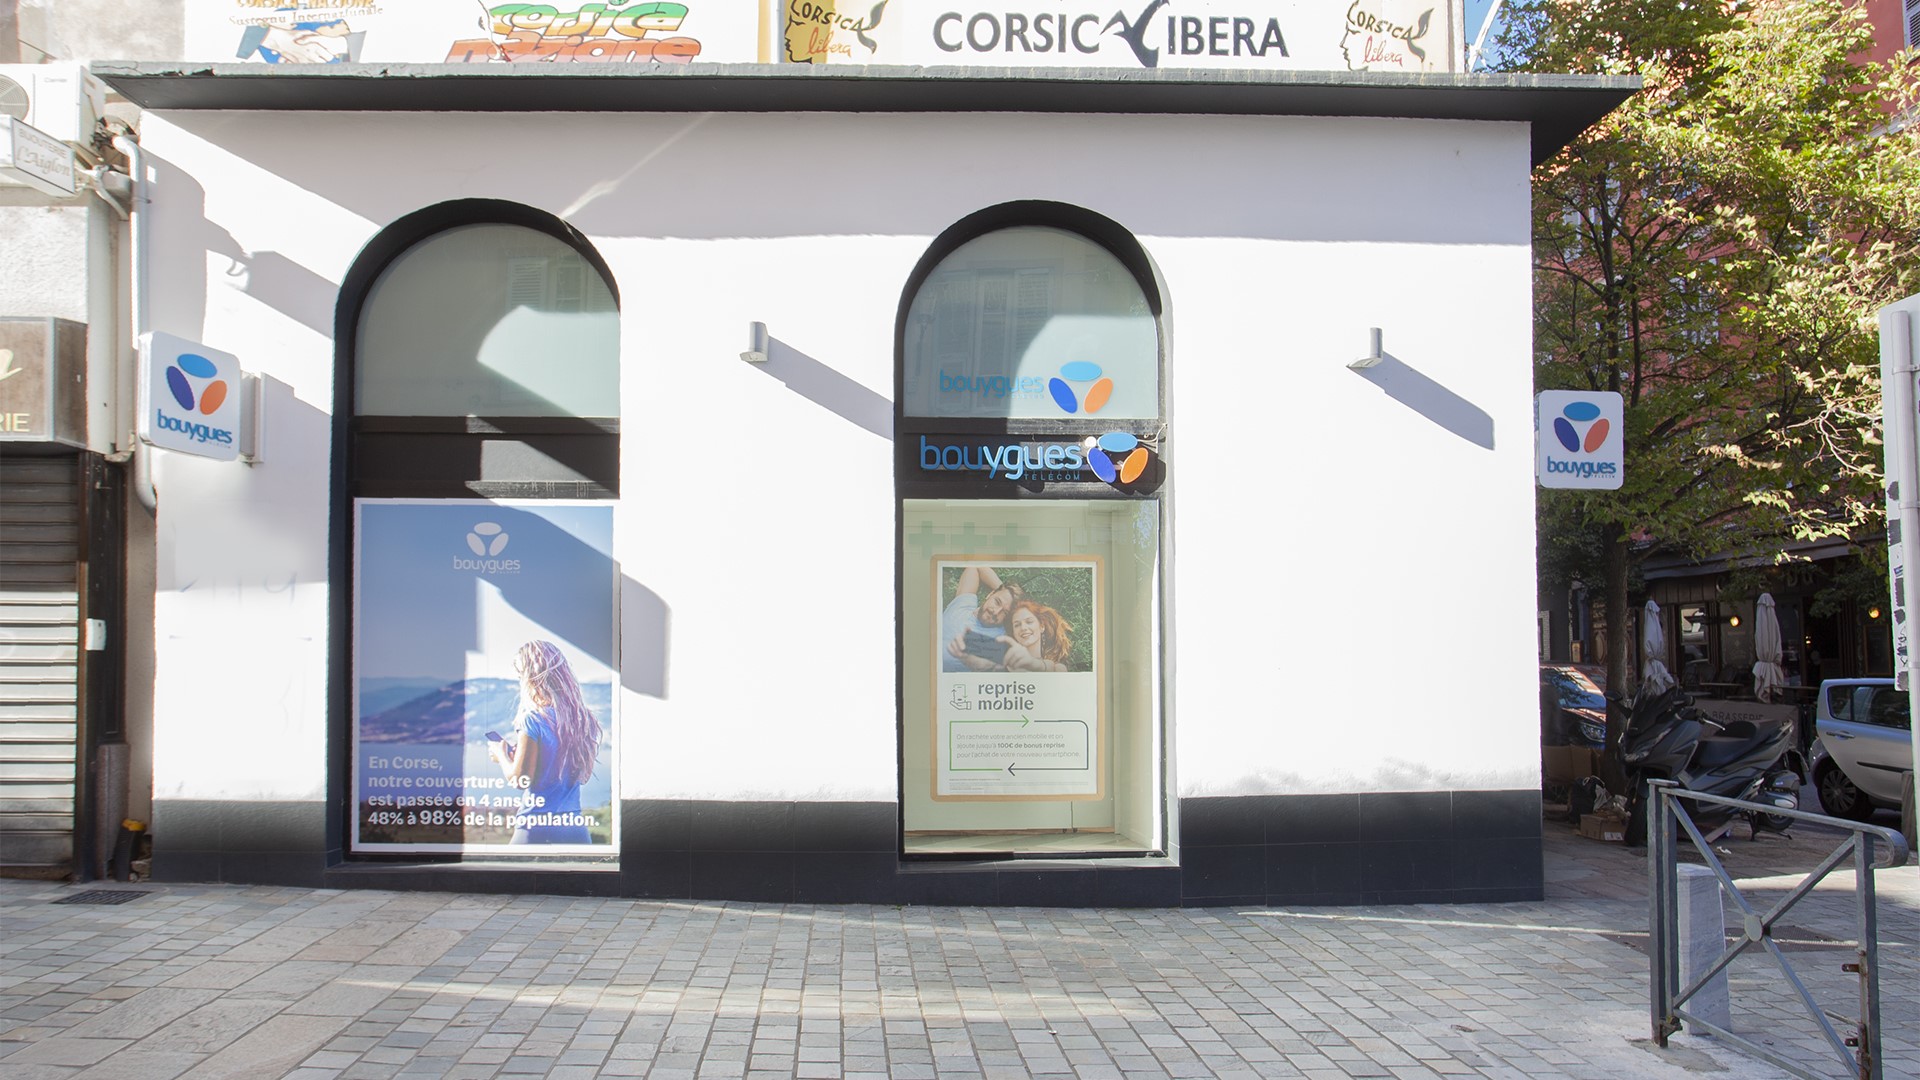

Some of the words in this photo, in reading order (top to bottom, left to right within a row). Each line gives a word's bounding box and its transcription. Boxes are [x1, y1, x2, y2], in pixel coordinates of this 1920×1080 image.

[940, 368, 1046, 399] bouygues
[157, 408, 233, 445] bouygues
[919, 434, 1084, 481] bouygues
[1547, 455, 1617, 479] bouygues
[1023, 472, 1082, 481] TELECOM
[453, 554, 521, 575] bouygues
[978, 680, 1036, 698] reprise
[978, 696, 1034, 711] mobile
[1043, 742, 1066, 750] reprise
[368, 755, 389, 769] En
[391, 755, 443, 771] Corse,
[368, 775, 413, 788] notre
[415, 775, 505, 789] couverture
[507, 775, 531, 788] 4G
[368, 794, 394, 806] est
[396, 792, 454, 809] passée
[455, 795, 476, 807] en
[478, 794, 491, 807] 4
[493, 795, 523, 807] ans
[524, 793, 546, 807] de
[367, 811, 405, 825] 48%
[407, 811, 418, 825] à
[419, 810, 462, 825] 98%
[464, 811, 486, 826] de
[488, 811, 503, 826] la
[505, 811, 600, 830] population.
